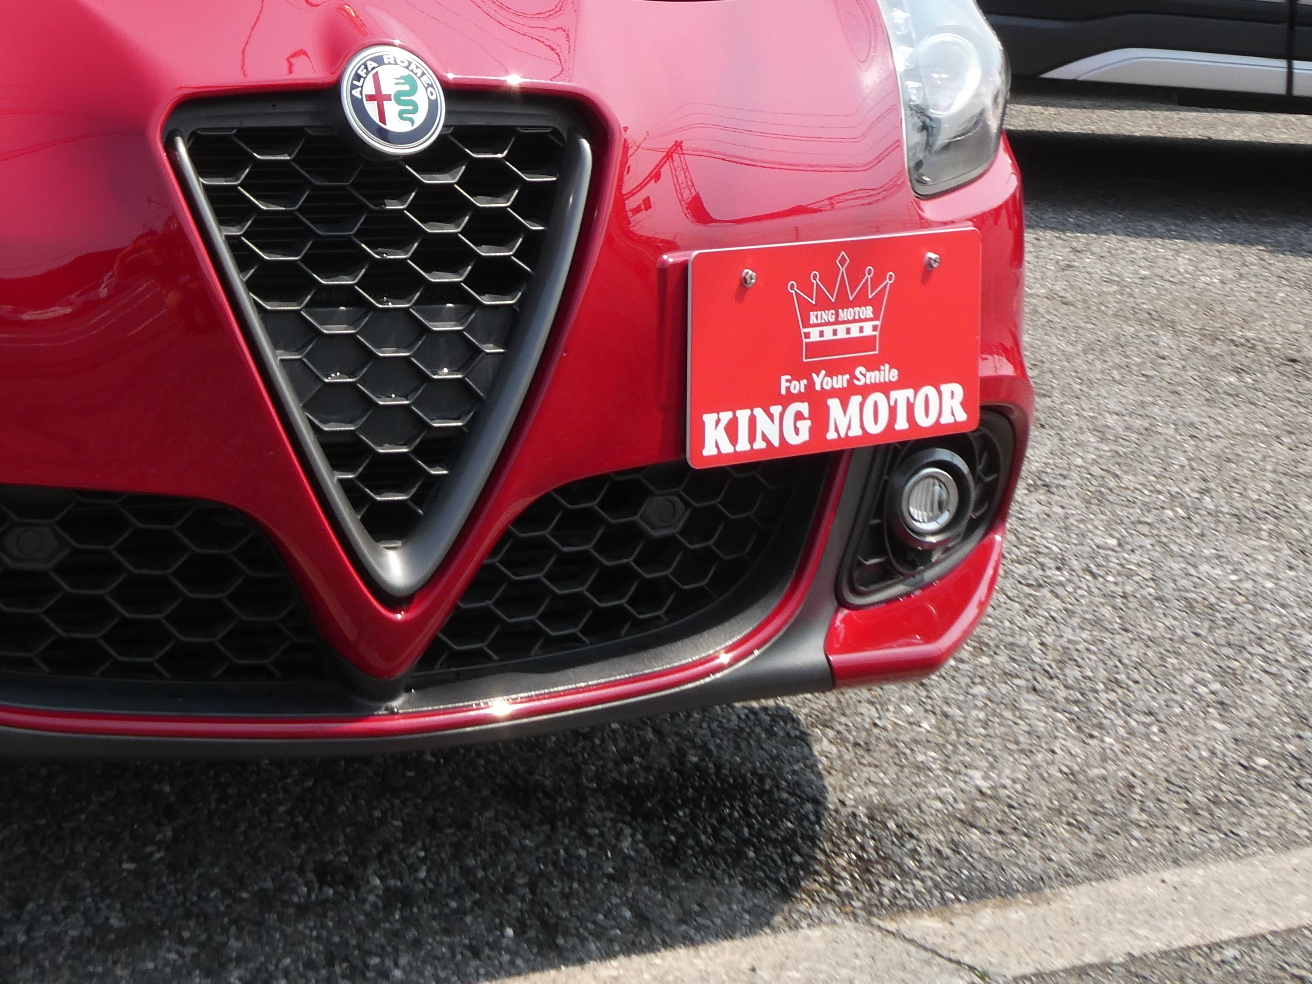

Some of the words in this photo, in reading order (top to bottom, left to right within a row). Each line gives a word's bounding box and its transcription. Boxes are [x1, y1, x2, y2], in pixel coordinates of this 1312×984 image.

[351, 60, 379, 99] ALFA
[382, 54, 437, 100] ROMEO
[809, 308, 836, 324] KING
[838, 305, 874, 321] MOTOR
[780, 375, 807, 395] For
[812, 369, 850, 392] Your
[853, 363, 899, 386] Smile
[702, 401, 812, 456] KING
[826, 382, 968, 440] MOTOR
